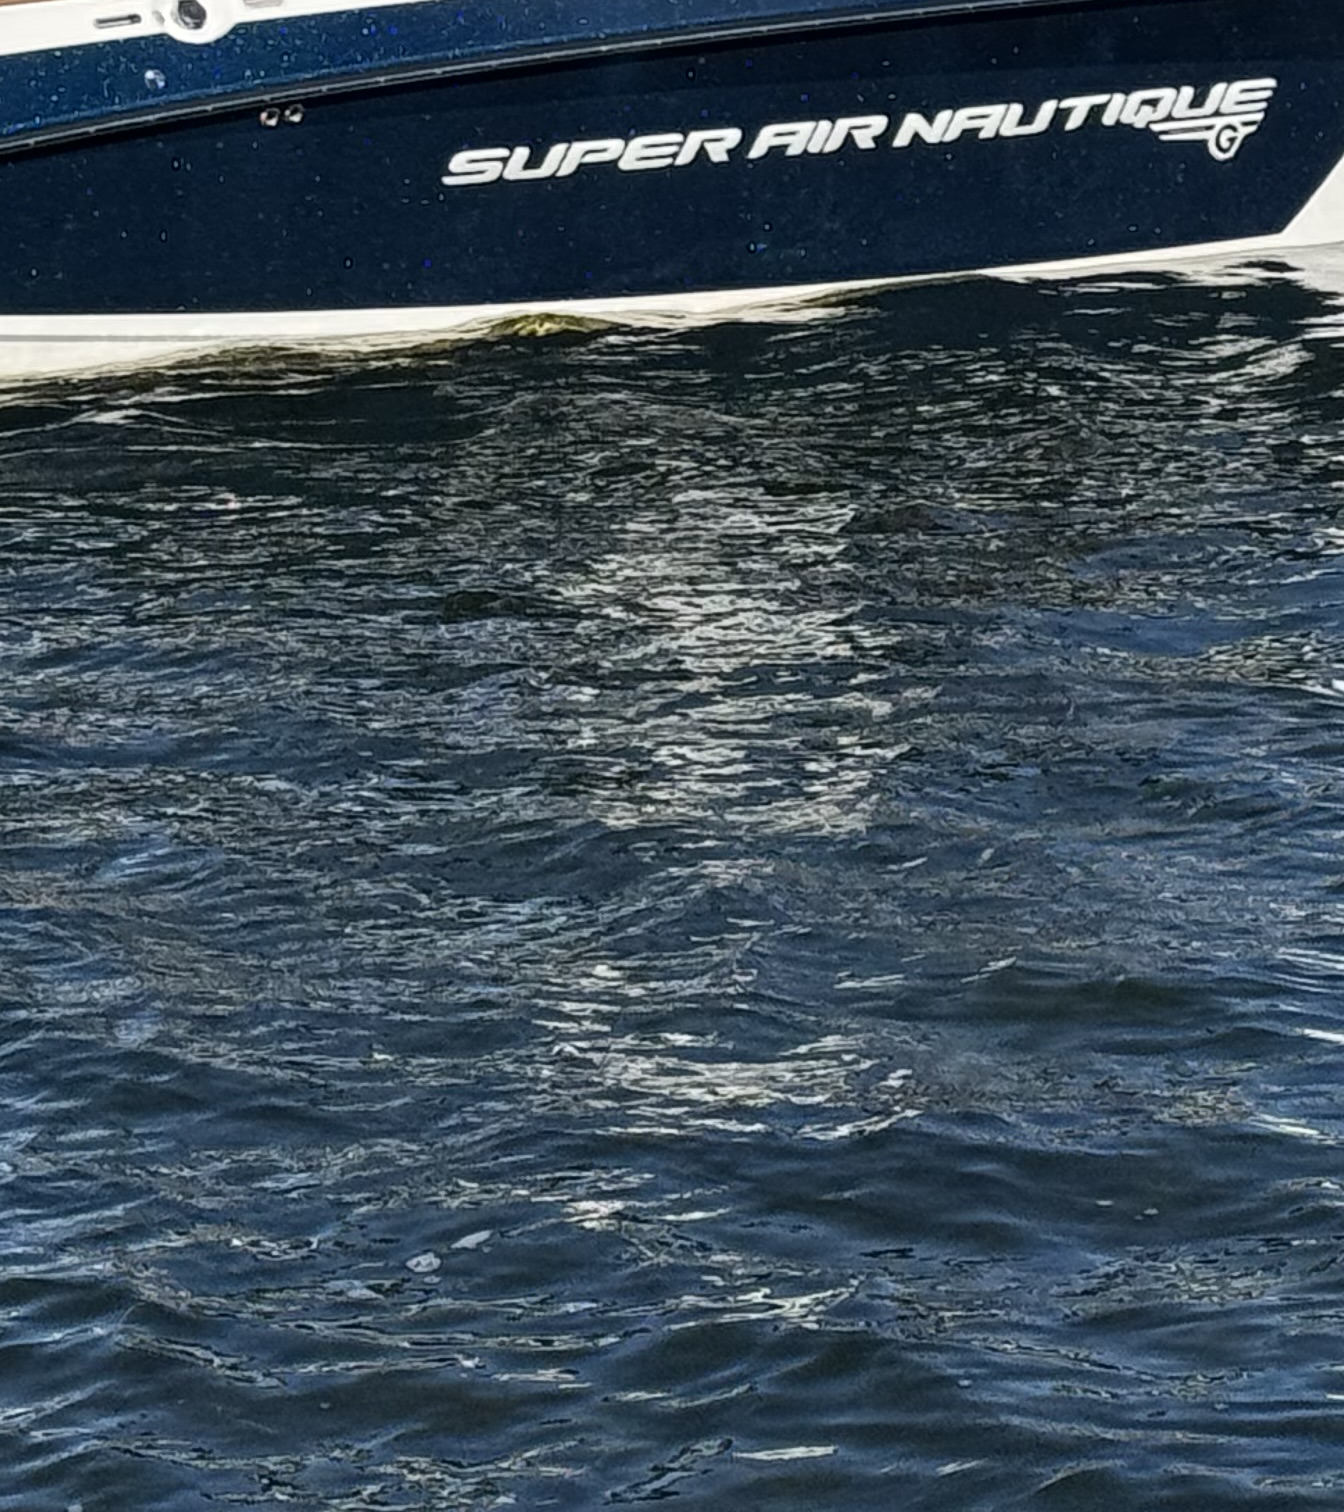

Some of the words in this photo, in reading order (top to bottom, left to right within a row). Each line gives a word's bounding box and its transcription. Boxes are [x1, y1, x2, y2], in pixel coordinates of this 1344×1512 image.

[441, 126, 743, 186] SUPER
[747, 113, 889, 159] AIR
[892, 77, 1278, 148] NAUTIQUE
